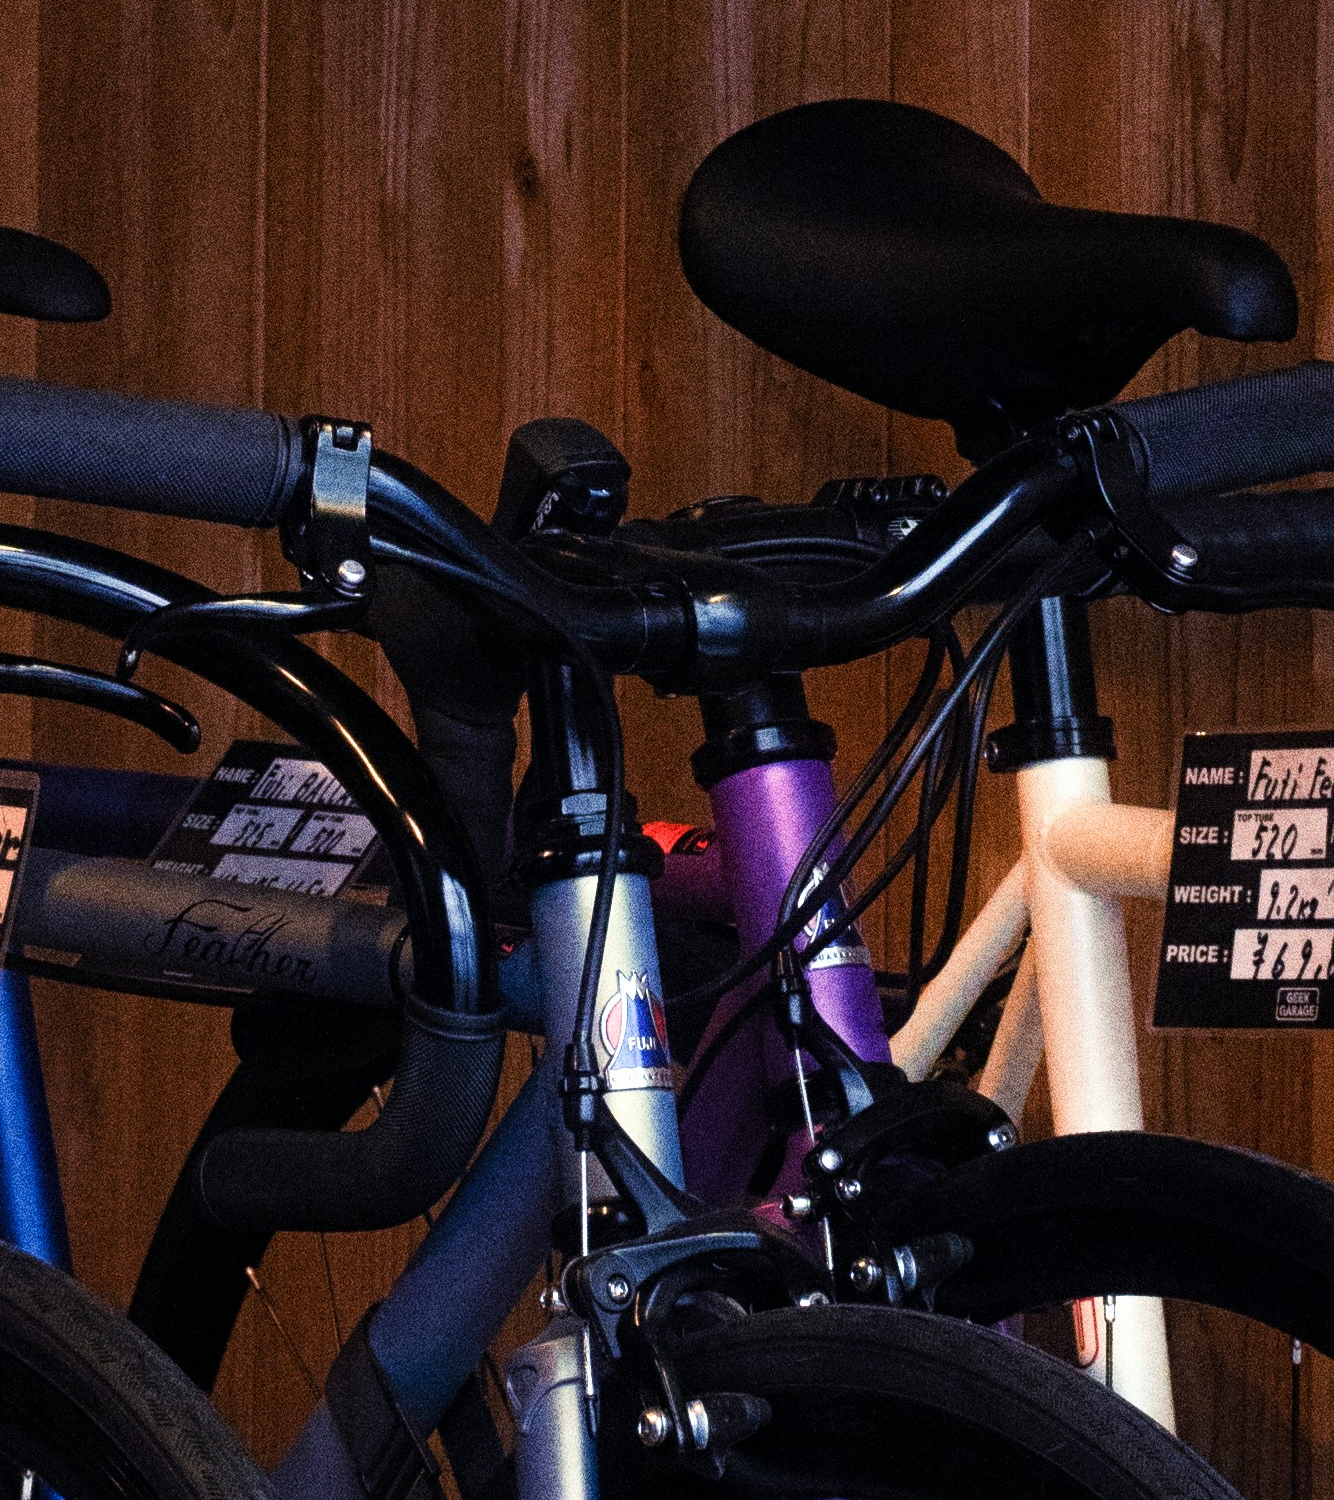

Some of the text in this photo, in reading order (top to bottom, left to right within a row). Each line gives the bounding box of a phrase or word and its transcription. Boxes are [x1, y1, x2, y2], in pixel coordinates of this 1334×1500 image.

[1252, 757, 1302, 799] Fuji
[1251, 823, 1298, 859] 520
[143, 899, 318, 984] Feather
[628, 1036, 657, 1052] FUJI
